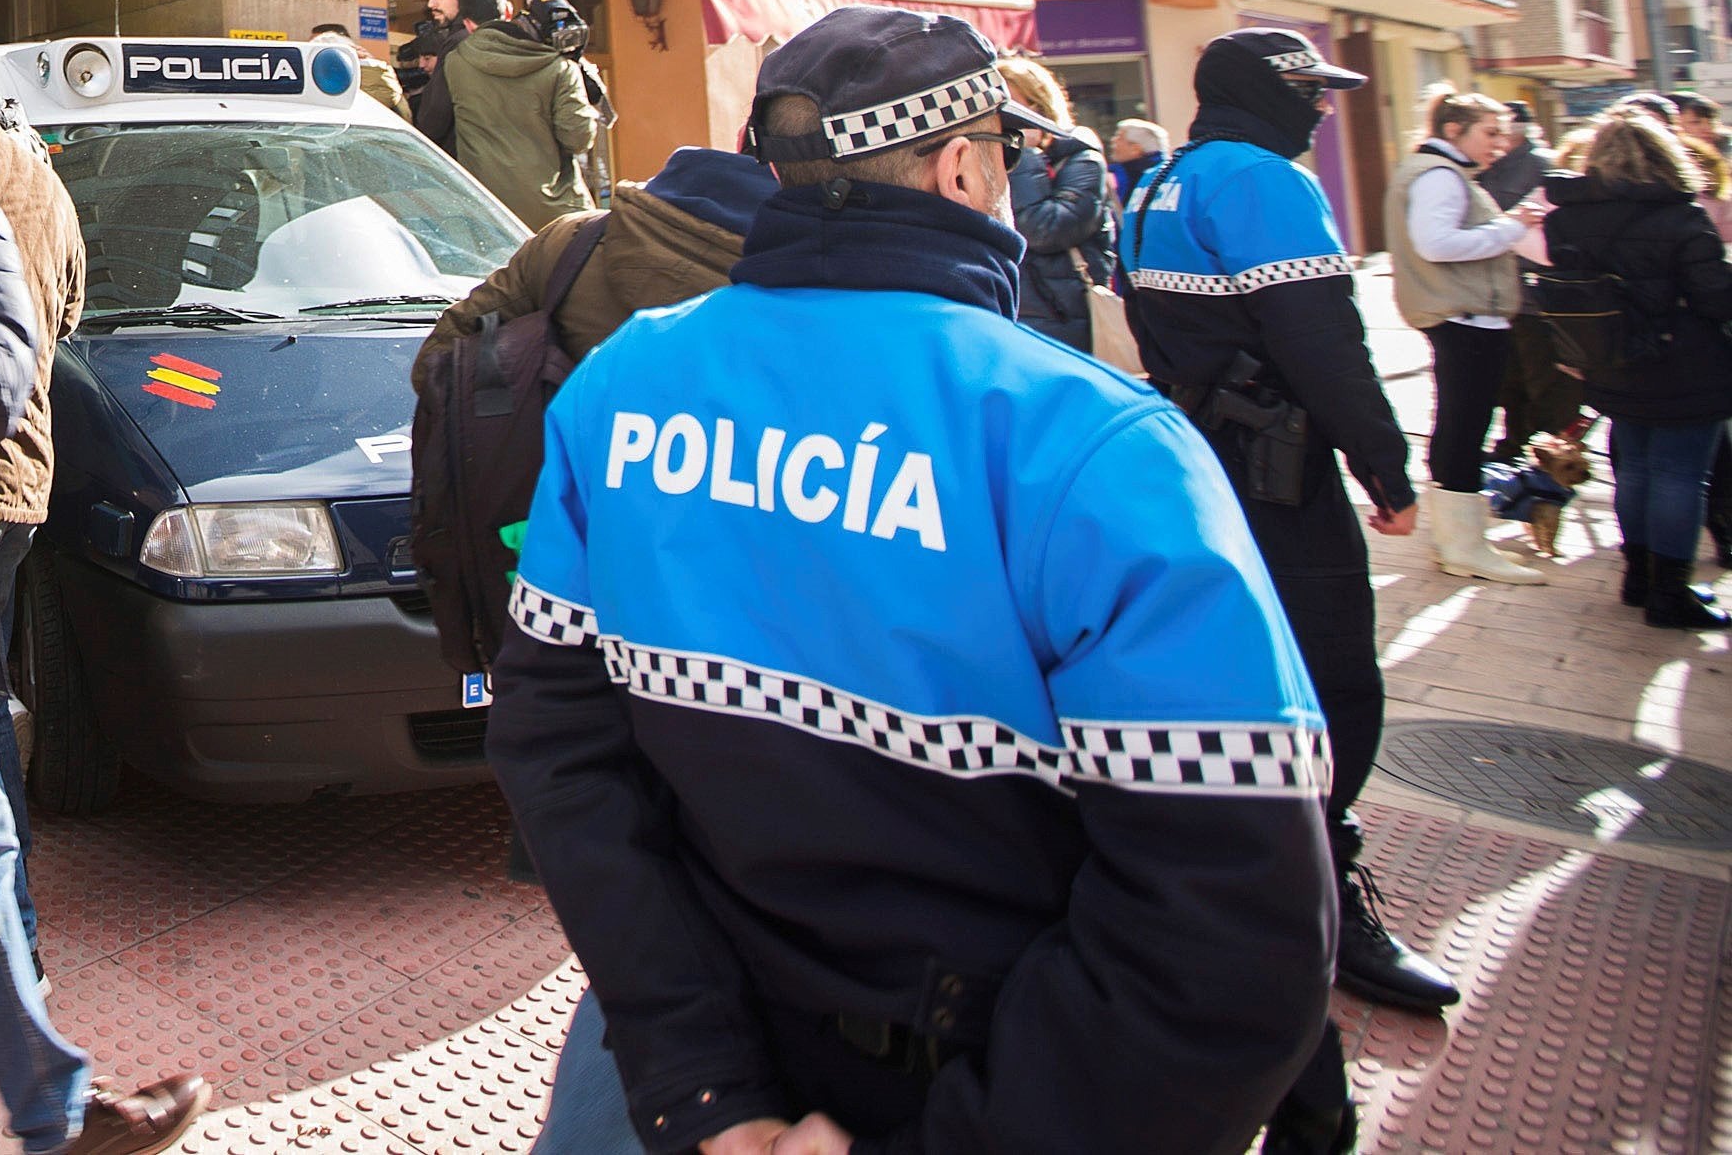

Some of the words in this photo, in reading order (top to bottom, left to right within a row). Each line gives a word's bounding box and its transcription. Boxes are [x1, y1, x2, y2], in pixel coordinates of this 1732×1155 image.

[129, 53, 298, 81] POLICÍA
[354, 434, 413, 463] P
[605, 411, 947, 552] POLICÍA
[470, 684, 479, 696] E
